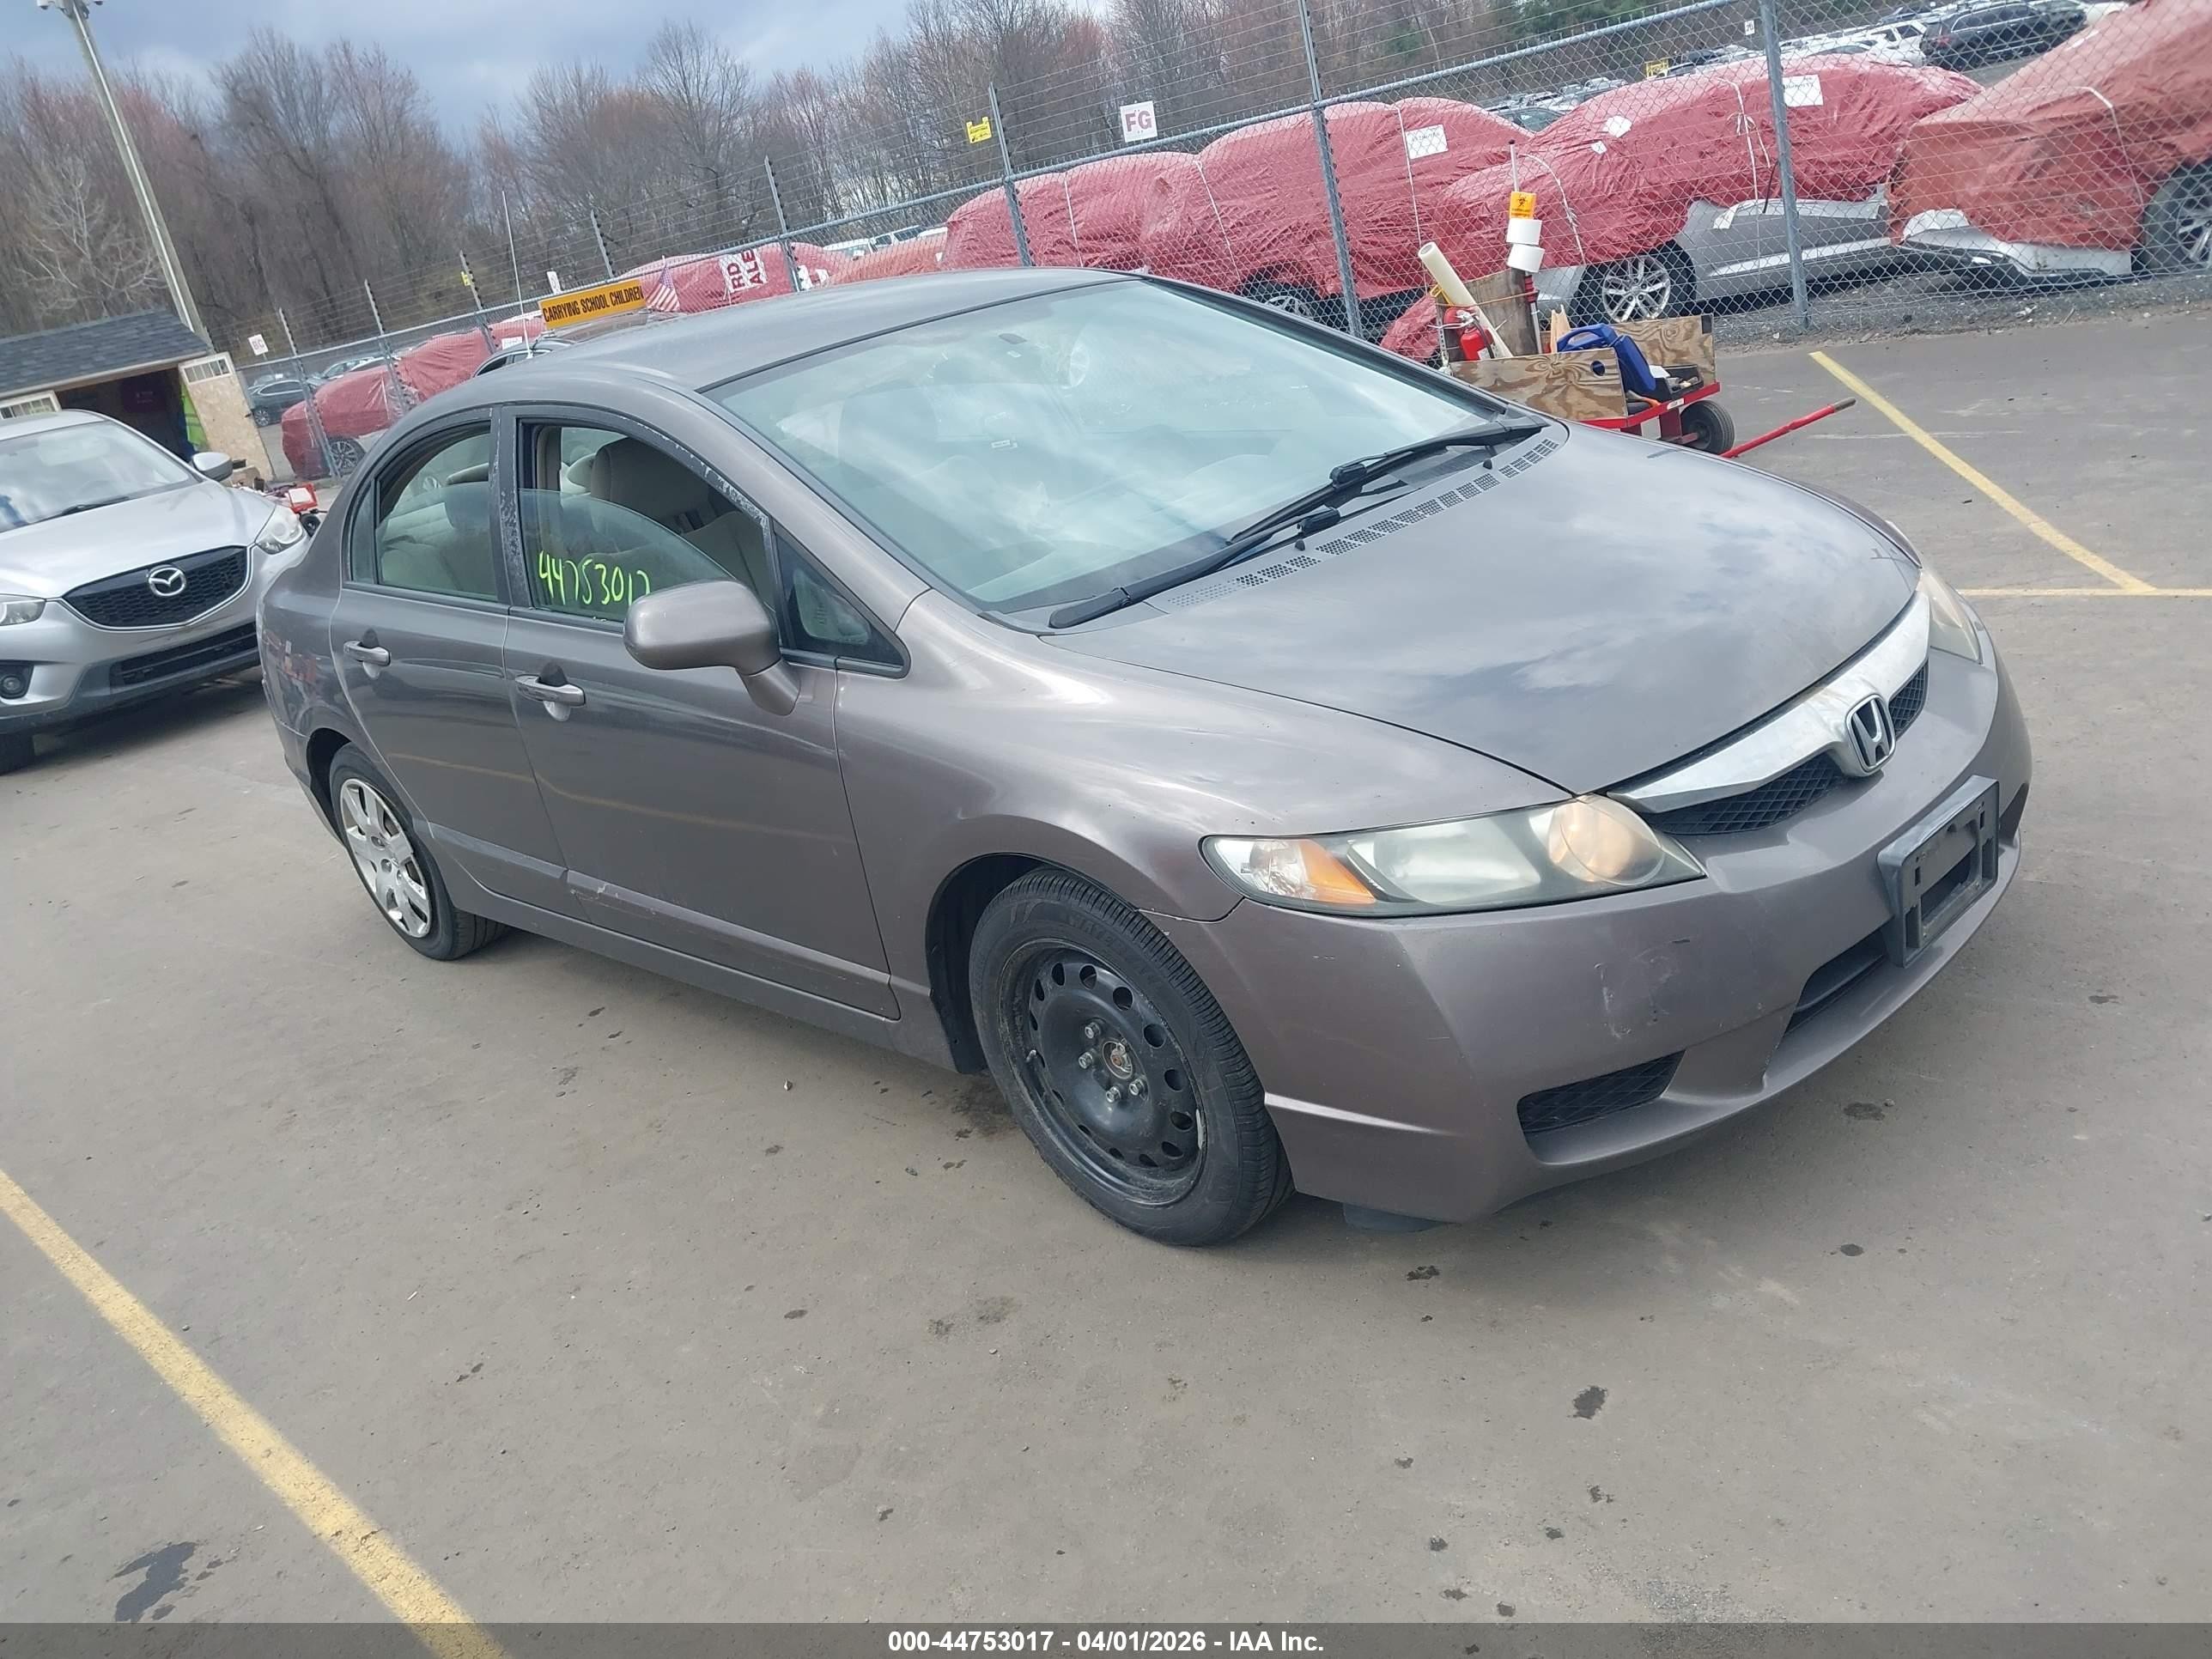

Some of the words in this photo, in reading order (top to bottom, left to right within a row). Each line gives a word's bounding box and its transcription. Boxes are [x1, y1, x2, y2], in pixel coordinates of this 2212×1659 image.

[1125, 110, 1152, 132] FG
[542, 301, 580, 322] CARRYING
[580, 295, 610, 313] SCHOOL
[609, 285, 645, 306] CHILDREN
